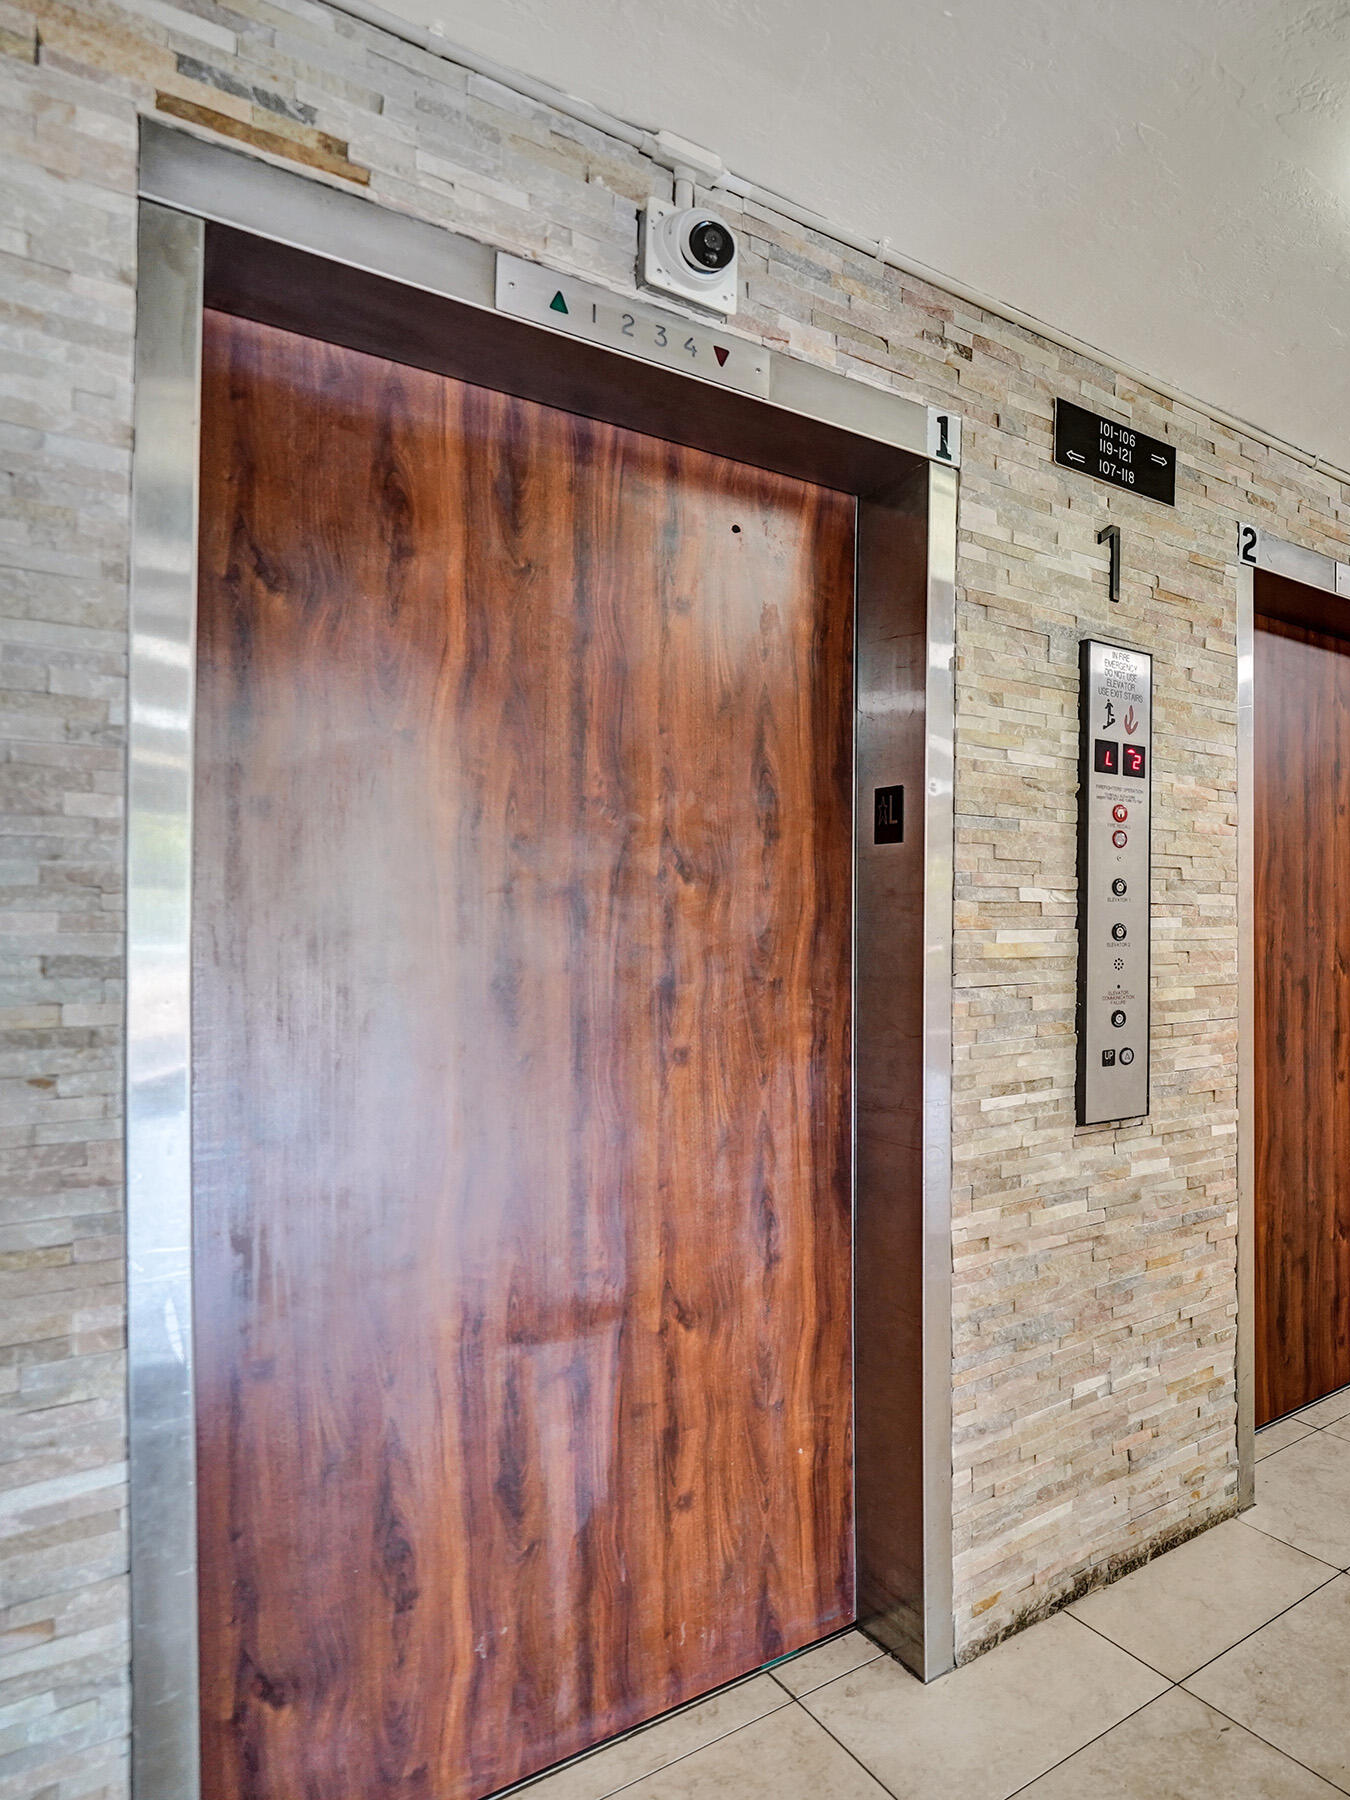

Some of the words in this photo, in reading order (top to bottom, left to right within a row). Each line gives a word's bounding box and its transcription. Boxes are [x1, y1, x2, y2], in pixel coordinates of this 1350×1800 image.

[622, 313, 635, 338] 2
[654, 324, 668, 348] 3
[684, 336, 698, 358] 4
[935, 415, 953, 461] 1
[1100, 421, 1136, 448] 101-106
[1099, 438, 1132, 464] 119-121
[1099, 458, 1135, 485] 107-118
[1242, 526, 1257, 564] 2
[1097, 524, 1121, 603] 1
[1119, 652, 1131, 663] FIRE
[1104, 668, 1114, 678] DO
[1114, 670, 1126, 680] NOT
[1126, 673, 1138, 684] USE
[1106, 678, 1136, 692] ELEVATOR
[1097, 686, 1110, 697] USE
[1110, 688, 1123, 699] EXIT
[1123, 691, 1144, 704] STAIRS
[1105, 750, 1113, 767] L
[1132, 754, 1142, 771] 2
[1104, 1050, 1114, 1060] UP
